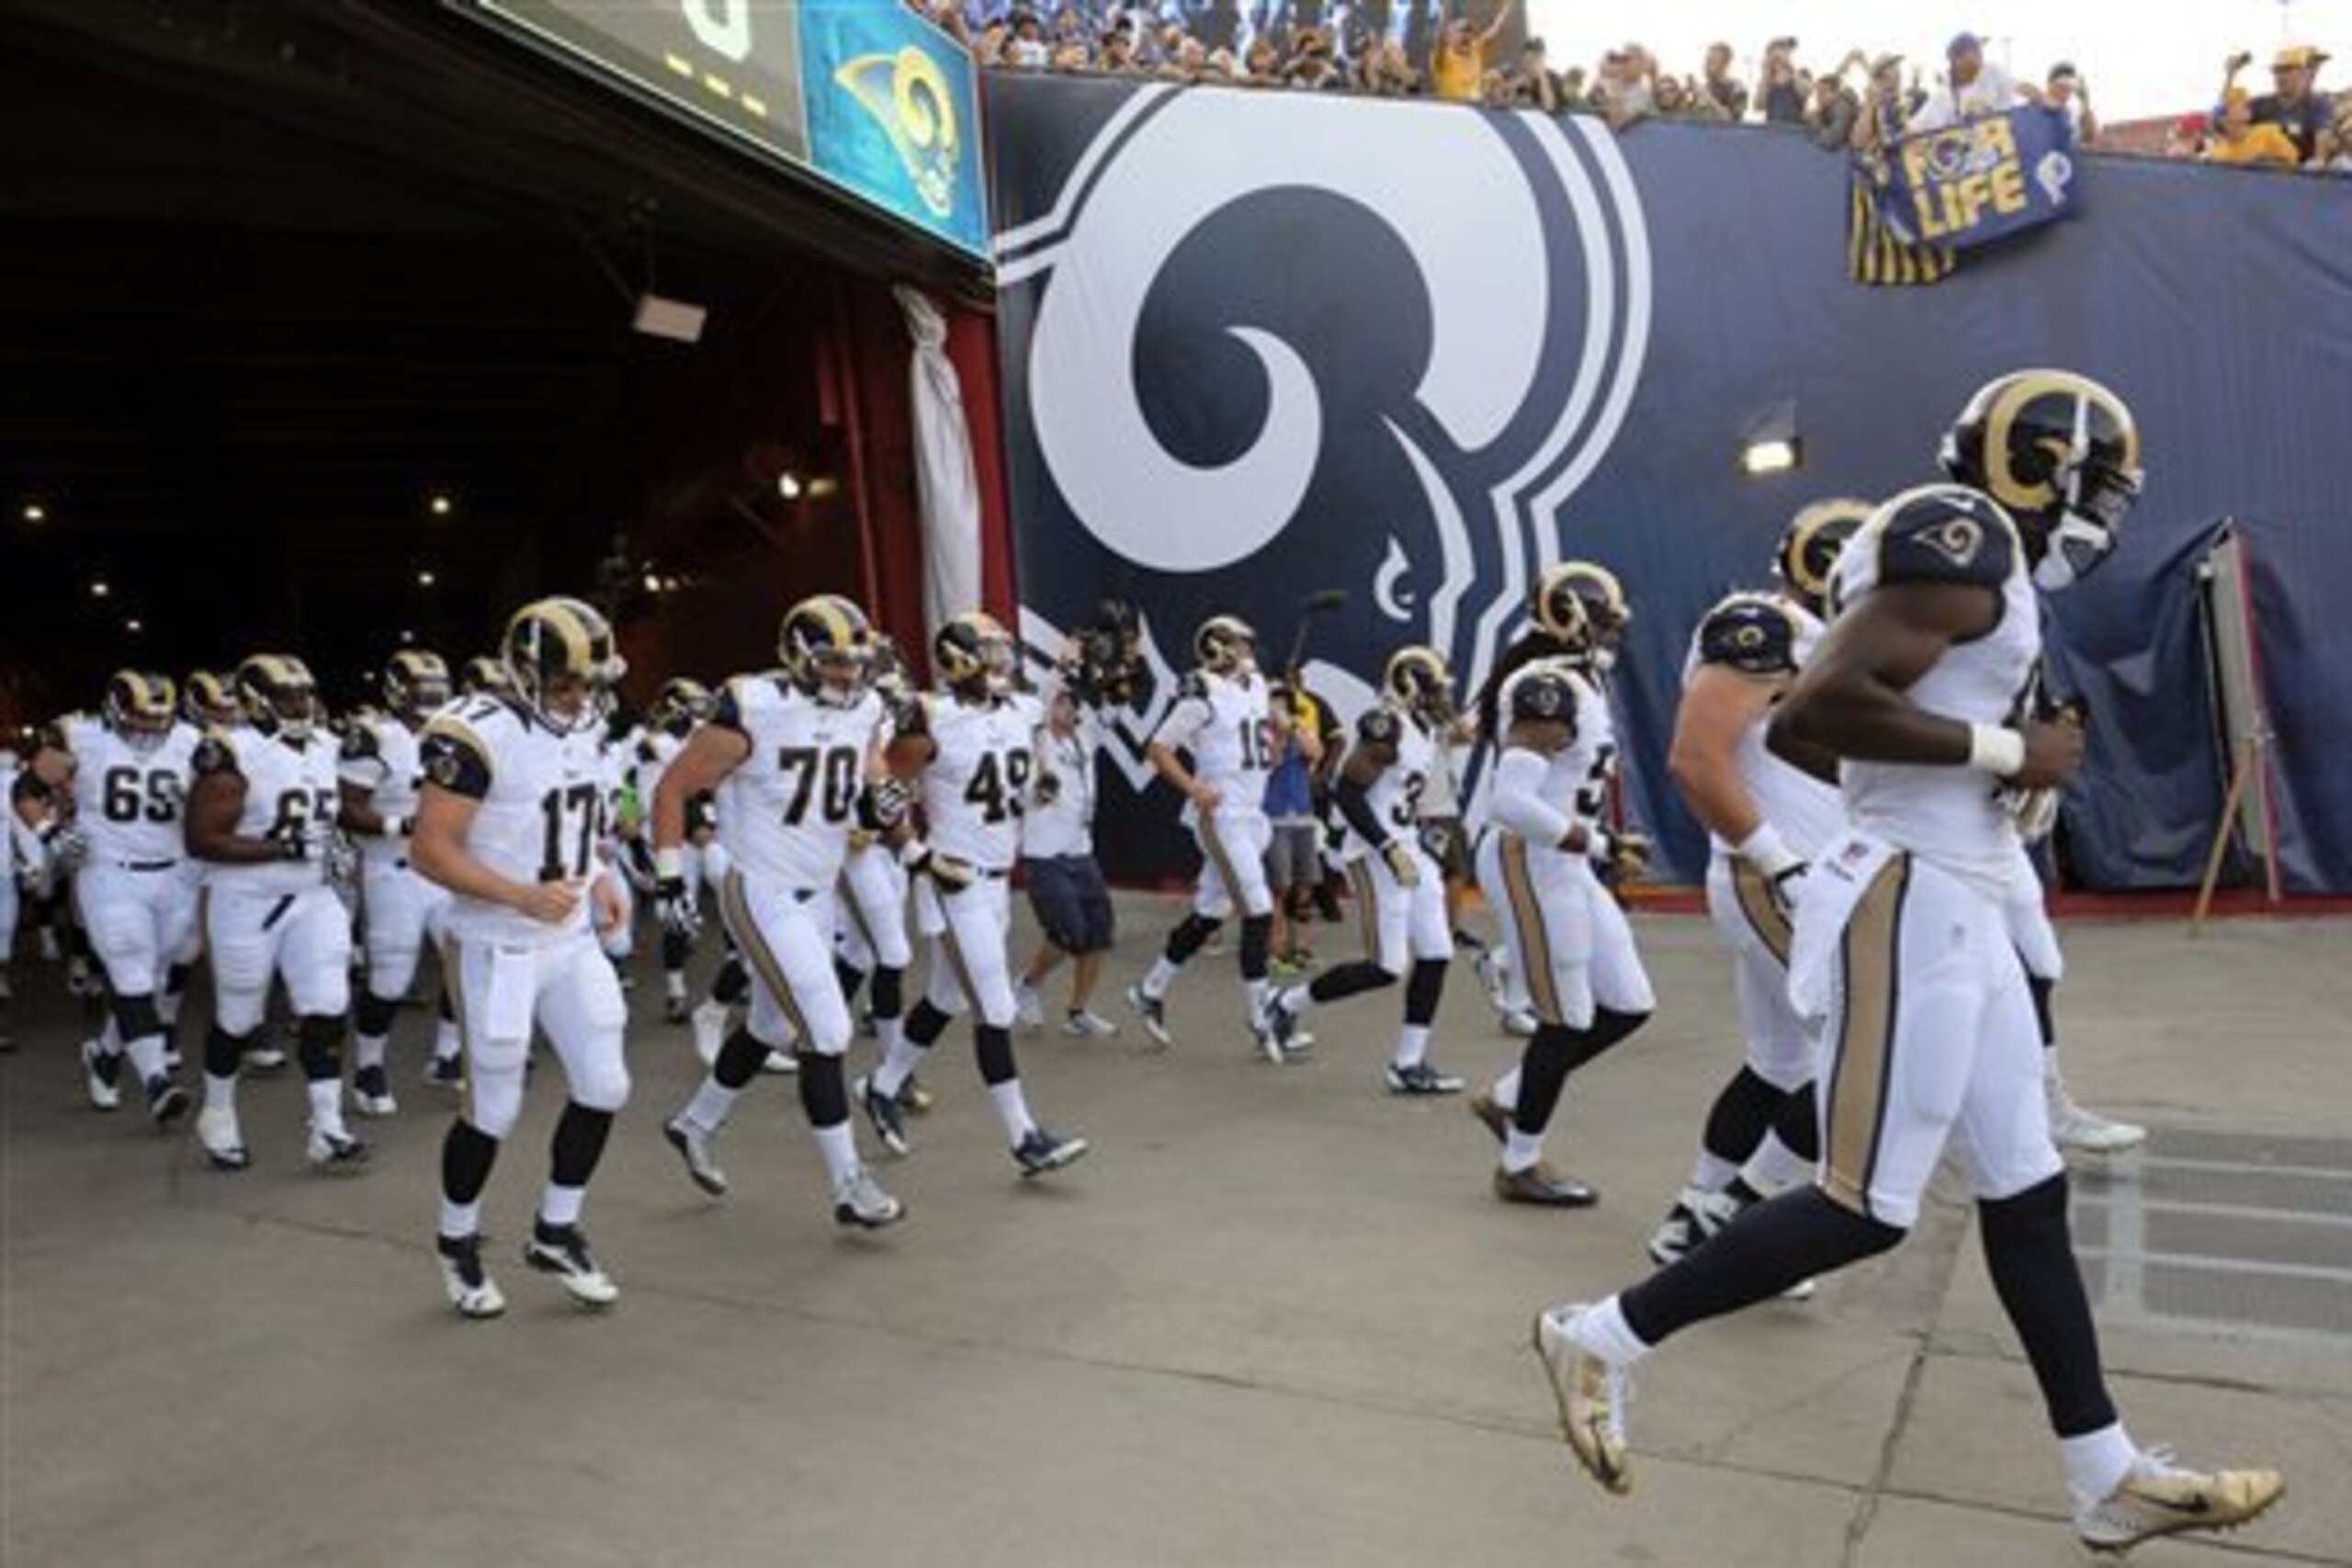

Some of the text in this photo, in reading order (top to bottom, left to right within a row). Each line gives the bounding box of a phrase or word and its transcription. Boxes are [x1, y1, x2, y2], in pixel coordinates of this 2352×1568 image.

[1914, 164, 2028, 239] LIFE
[778, 746, 857, 825] 70
[964, 749, 1030, 823] 49
[538, 783, 595, 881] 17
